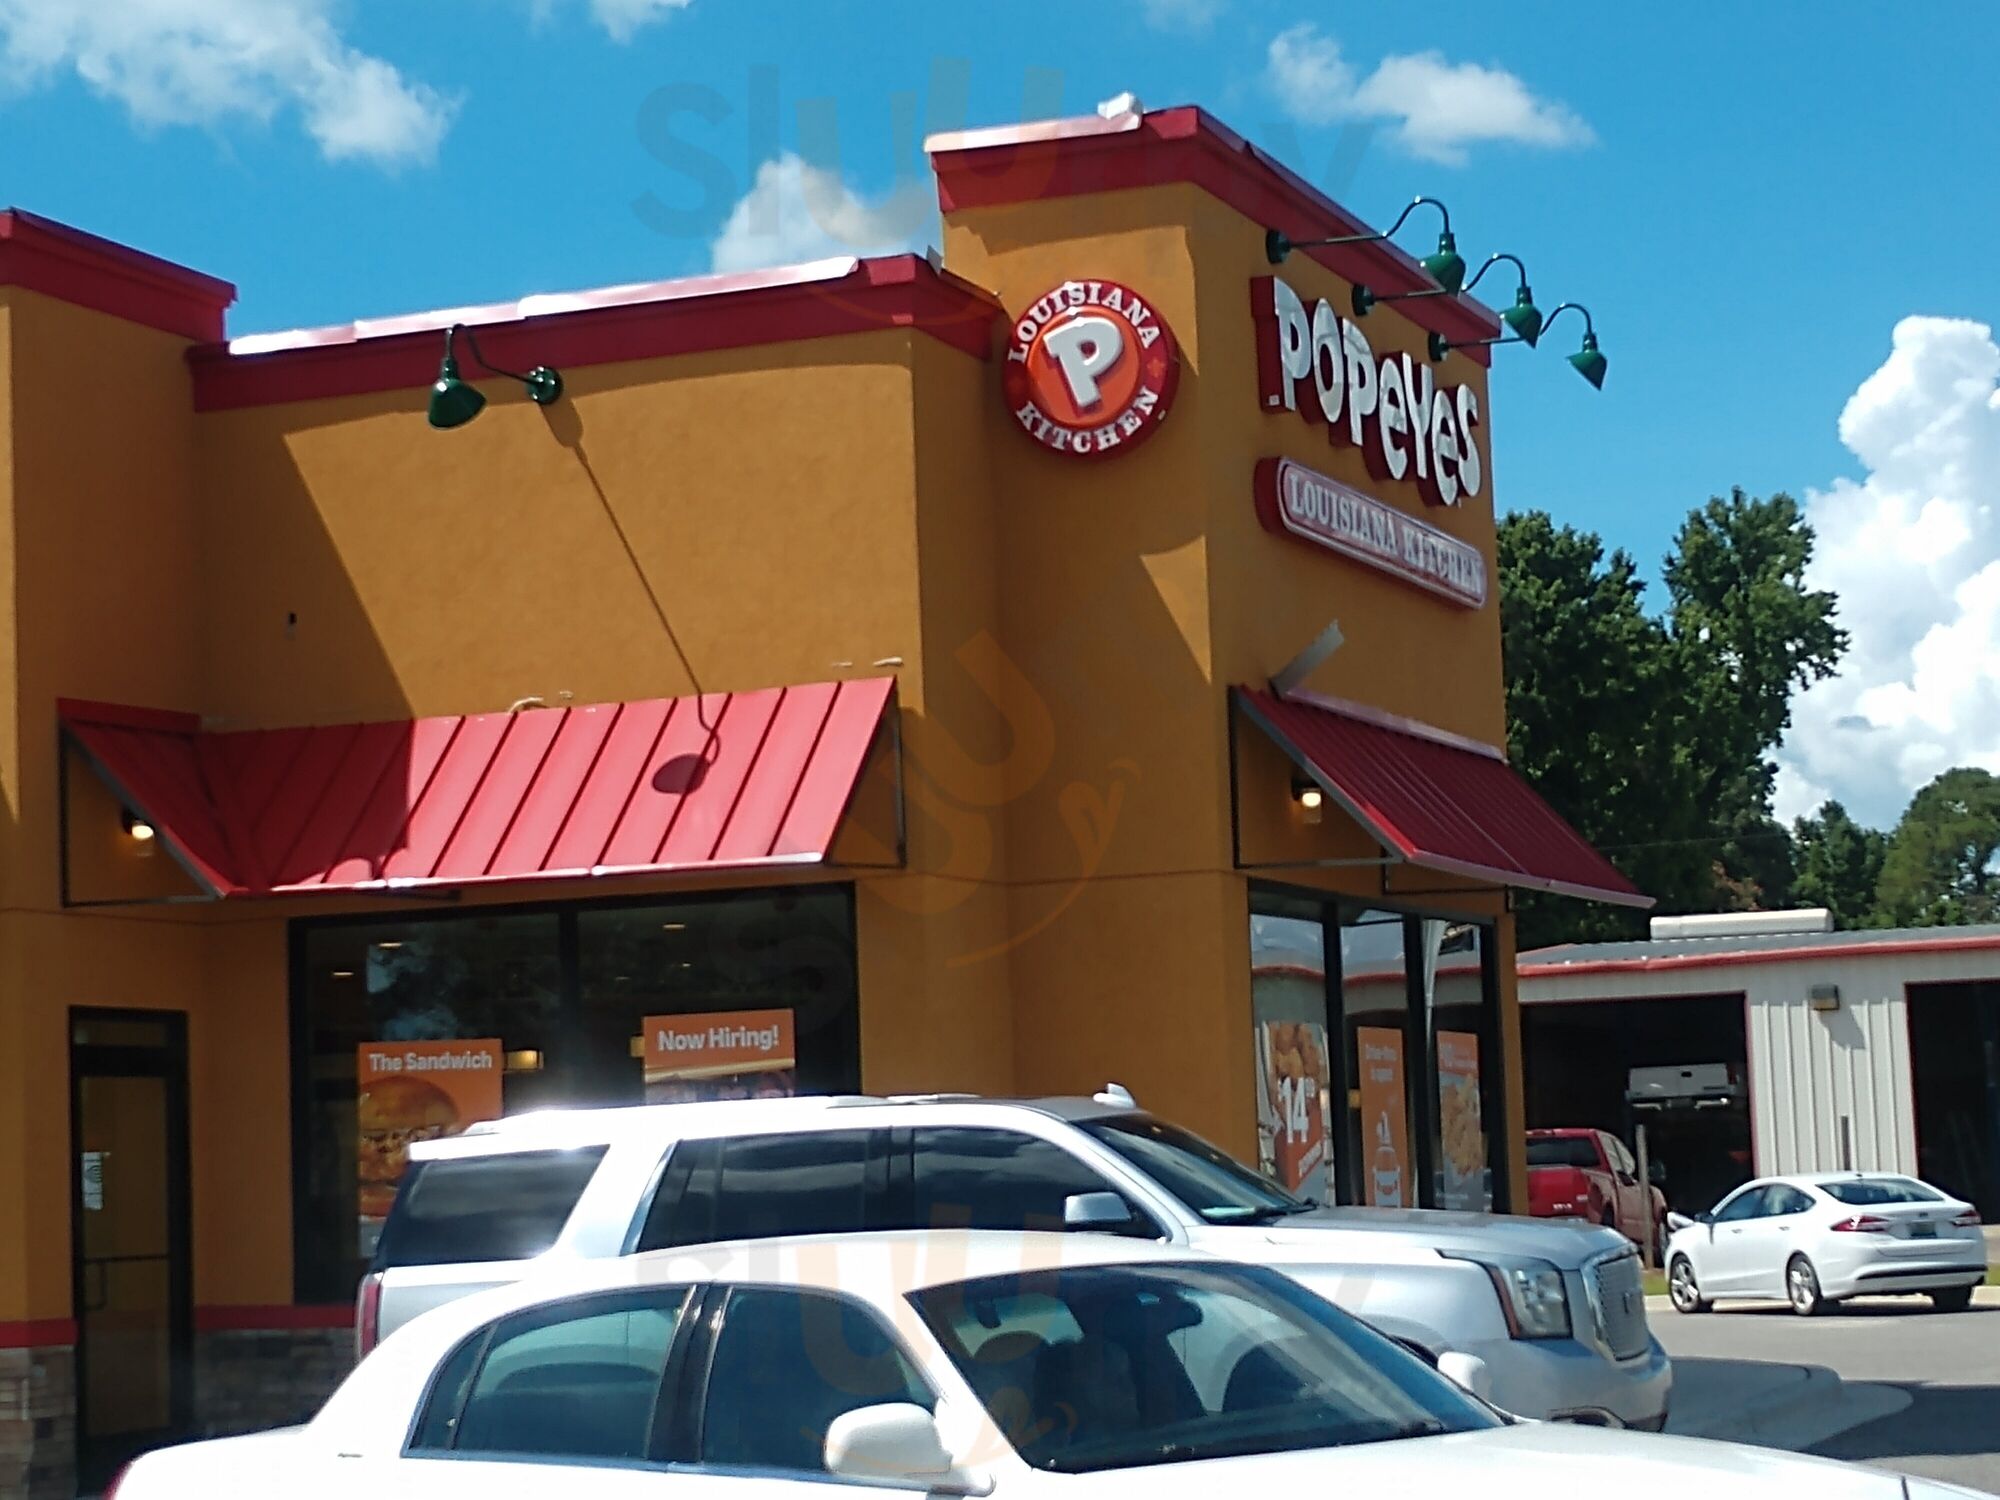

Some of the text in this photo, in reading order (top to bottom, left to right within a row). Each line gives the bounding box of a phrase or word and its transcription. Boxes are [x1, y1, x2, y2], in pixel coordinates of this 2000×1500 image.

[1008, 281, 1160, 364] LOUISIANA
[1043, 316, 1124, 408] P
[1016, 386, 1158, 453] KITCHEN
[1289, 473, 1482, 594] LOUISIANA KITCHEN
[368, 1050, 493, 1072] The Sandwich
[657, 1024, 779, 1051] Now Hiring!
